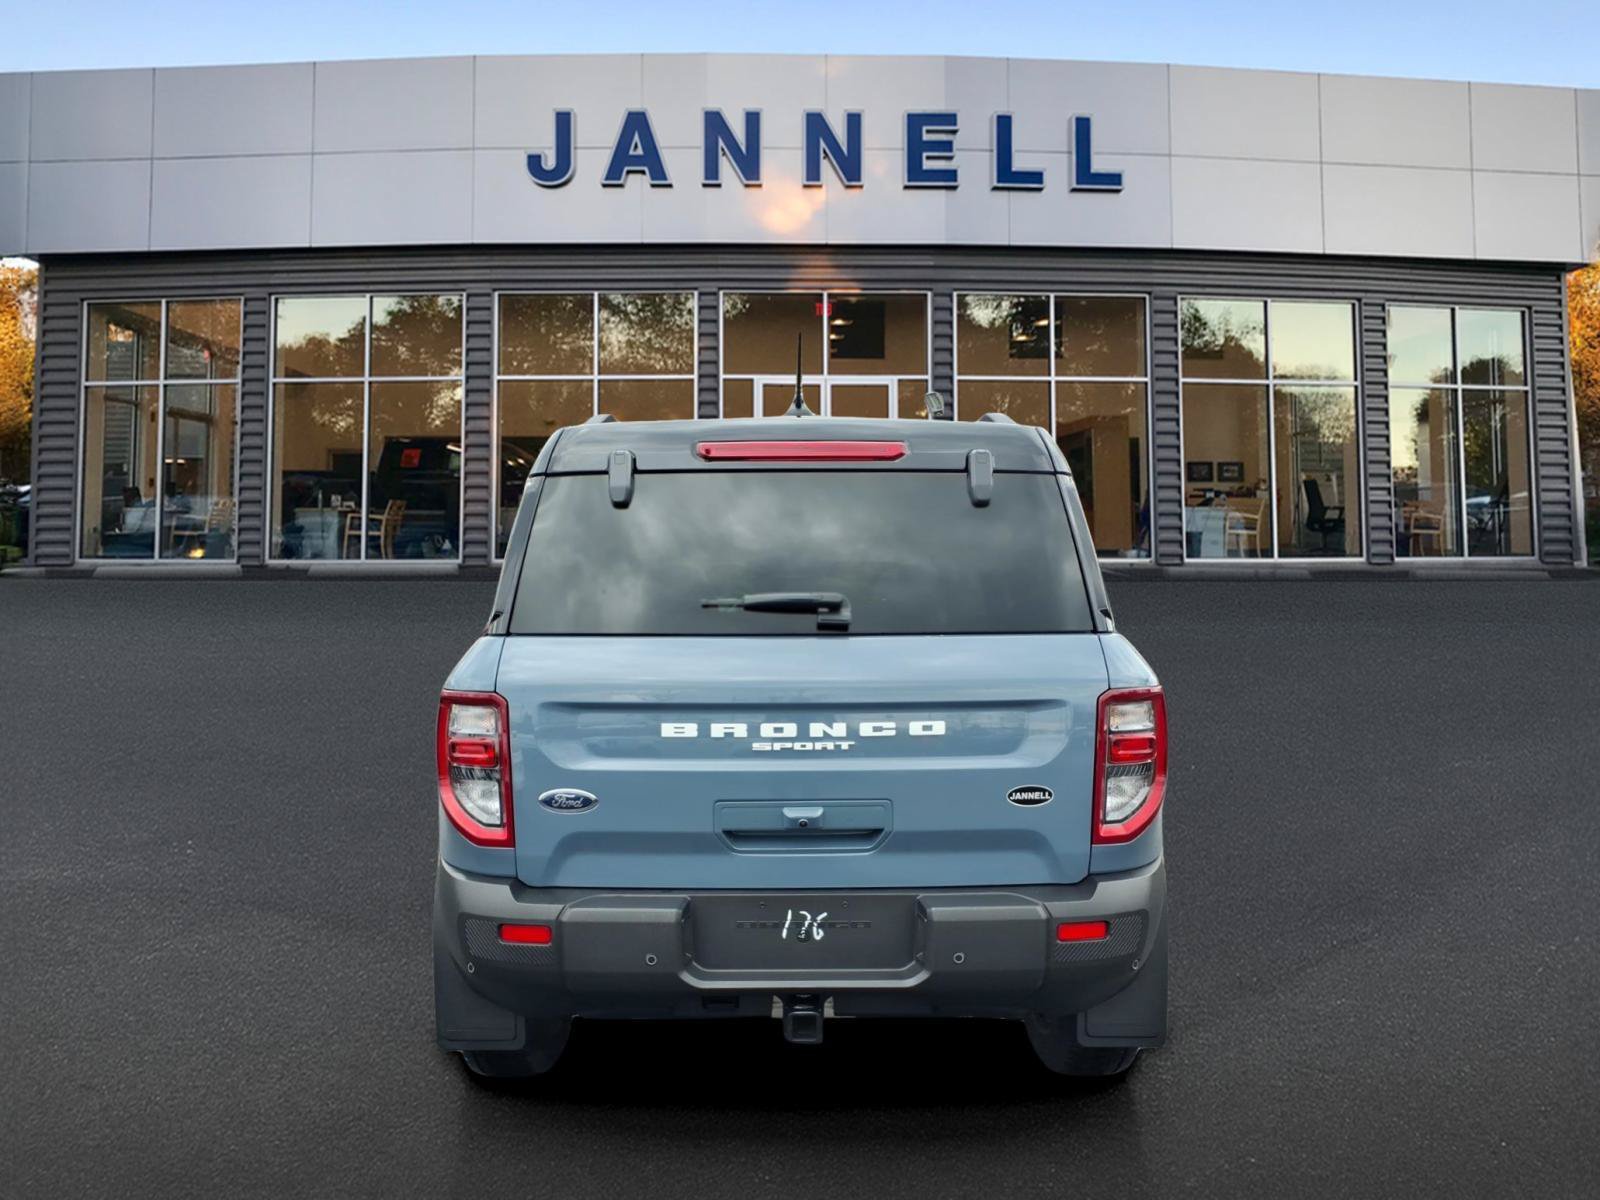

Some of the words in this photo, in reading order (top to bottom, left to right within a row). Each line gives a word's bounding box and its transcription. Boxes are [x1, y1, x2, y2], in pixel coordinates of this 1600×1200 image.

[525, 107, 1124, 192] JANNELL
[660, 720, 947, 738] BRONCO
[751, 741, 856, 752] SPORT
[551, 793, 584, 808] Ford
[1009, 791, 1051, 801] JANNELL
